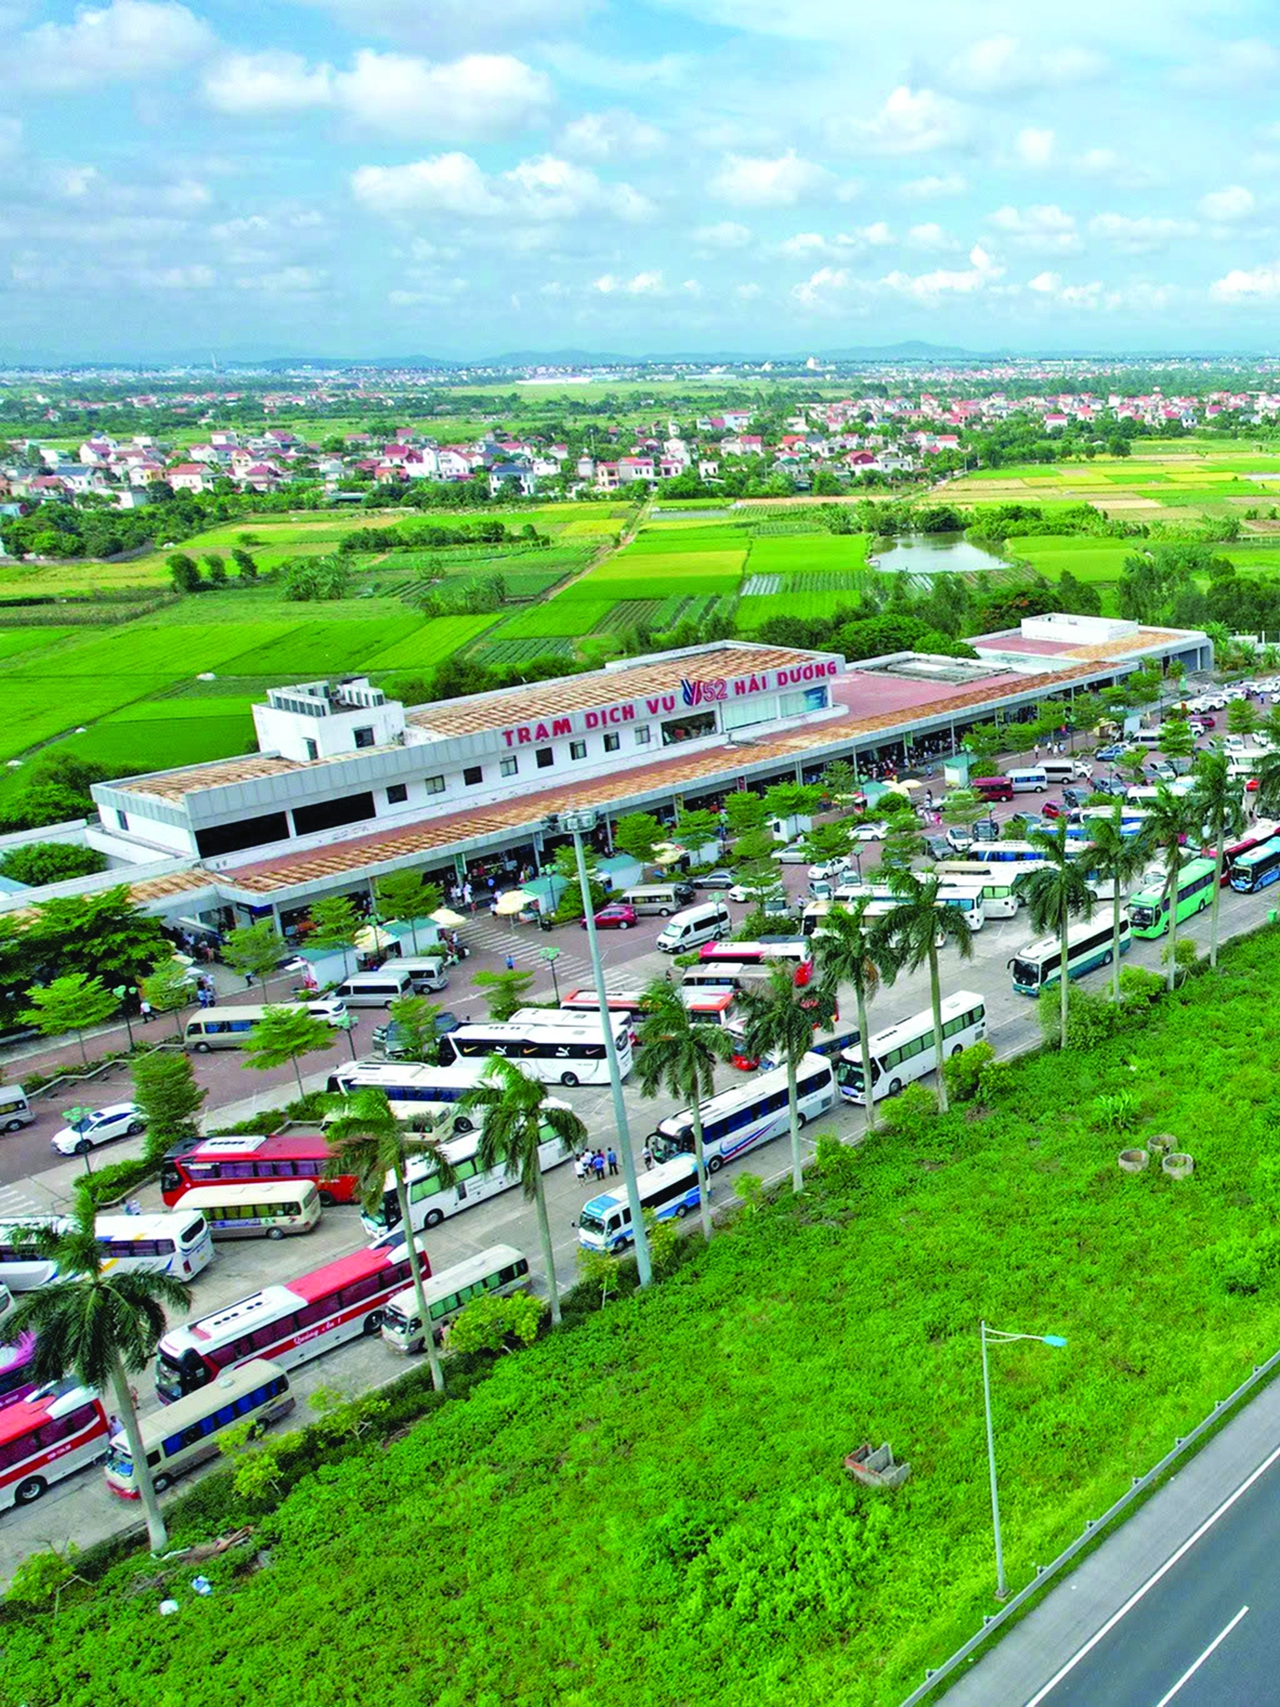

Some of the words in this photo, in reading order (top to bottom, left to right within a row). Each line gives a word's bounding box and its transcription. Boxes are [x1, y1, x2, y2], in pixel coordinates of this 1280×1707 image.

[502, 718, 572, 747] TRẠM
[586, 704, 635, 729] DỊCH
[646, 695, 676, 715] VỤ
[735, 674, 768, 696] HẢI
[777, 661, 837, 687] DƯƠNG
